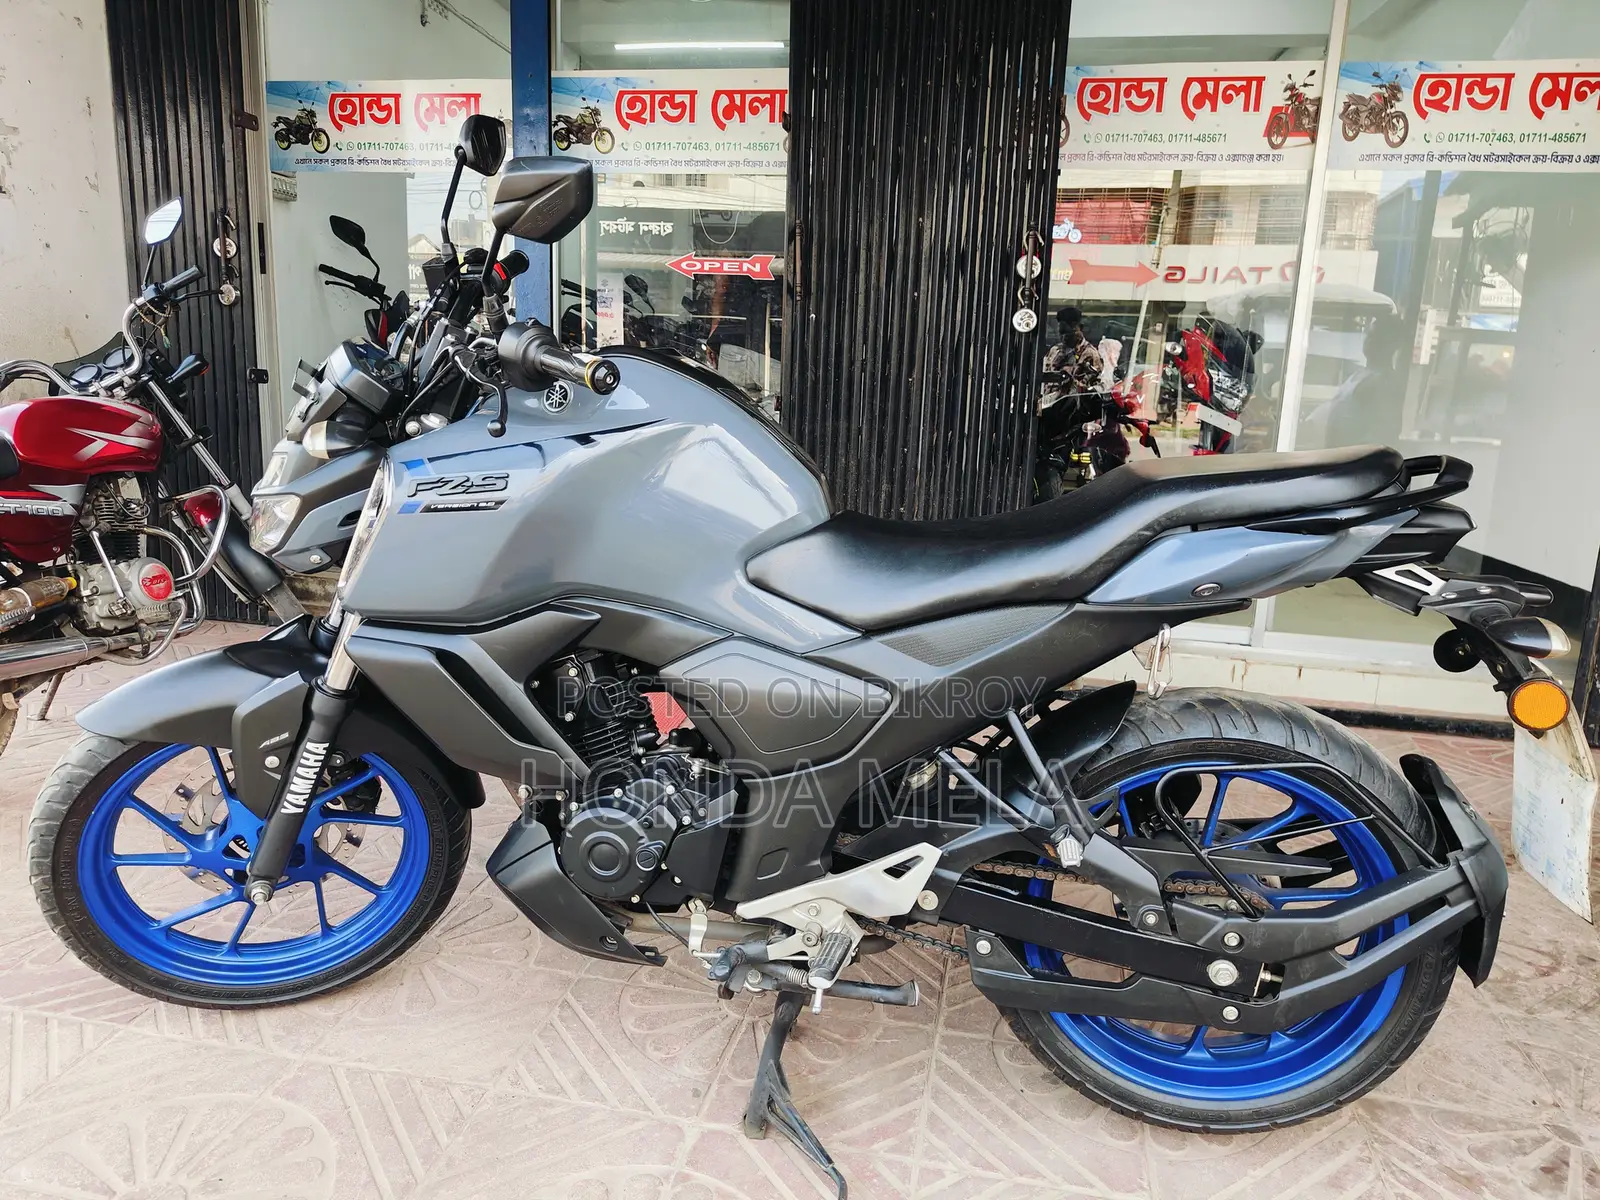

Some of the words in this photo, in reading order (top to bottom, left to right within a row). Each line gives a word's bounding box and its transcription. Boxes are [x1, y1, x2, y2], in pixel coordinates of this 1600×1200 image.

[1076, 76, 1169, 122] হোন্ডা
[1180, 76, 1267, 122] মেলা
[1413, 72, 1516, 121] হোন্ডা
[1529, 72, 1600, 121] মেল
[328, 92, 402, 132] হোন্ডা
[615, 89, 698, 132] হোন্ডা
[711, 89, 788, 132] মেলা
[357, 142, 417, 152] 01711-707463,
[645, 142, 712, 153] 01711-707463,
[715, 142, 780, 152] 01711-485671
[1104, 133, 1166, 144] 01711-707463,
[1167, 133, 1227, 143] 01711-485671
[1447, 132, 1516, 144] 01711-707463,
[1519, 132, 1587, 143] 01711-485671
[680, 260, 761, 272] OPEN
[280, 741, 330, 814] YAMAHA
